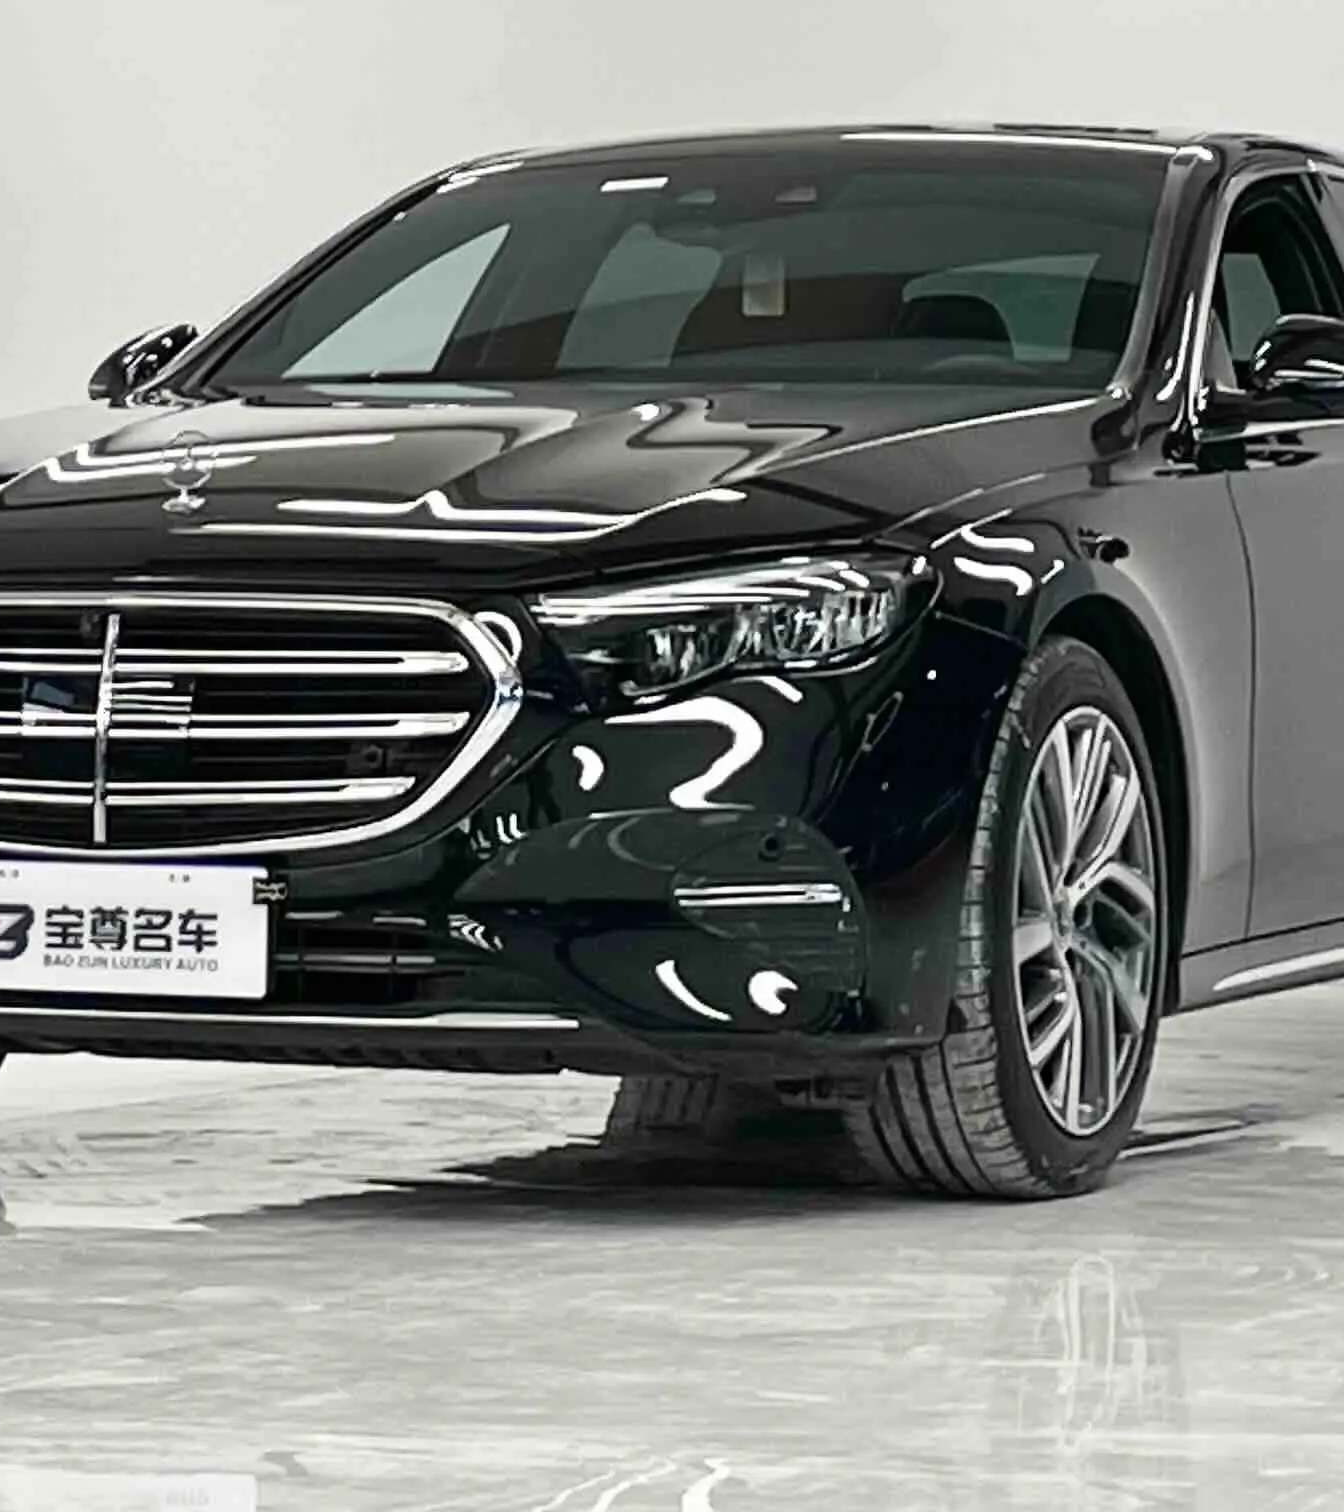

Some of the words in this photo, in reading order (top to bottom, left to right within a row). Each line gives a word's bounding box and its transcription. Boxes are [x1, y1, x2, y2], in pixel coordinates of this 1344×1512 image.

[44, 904, 218, 954] 宝尊名车
[43, 954, 75, 968] BAO
[77, 955, 108, 969] ZUN
[111, 956, 173, 970] LUXURY
[176, 958, 219, 972] AUTO
